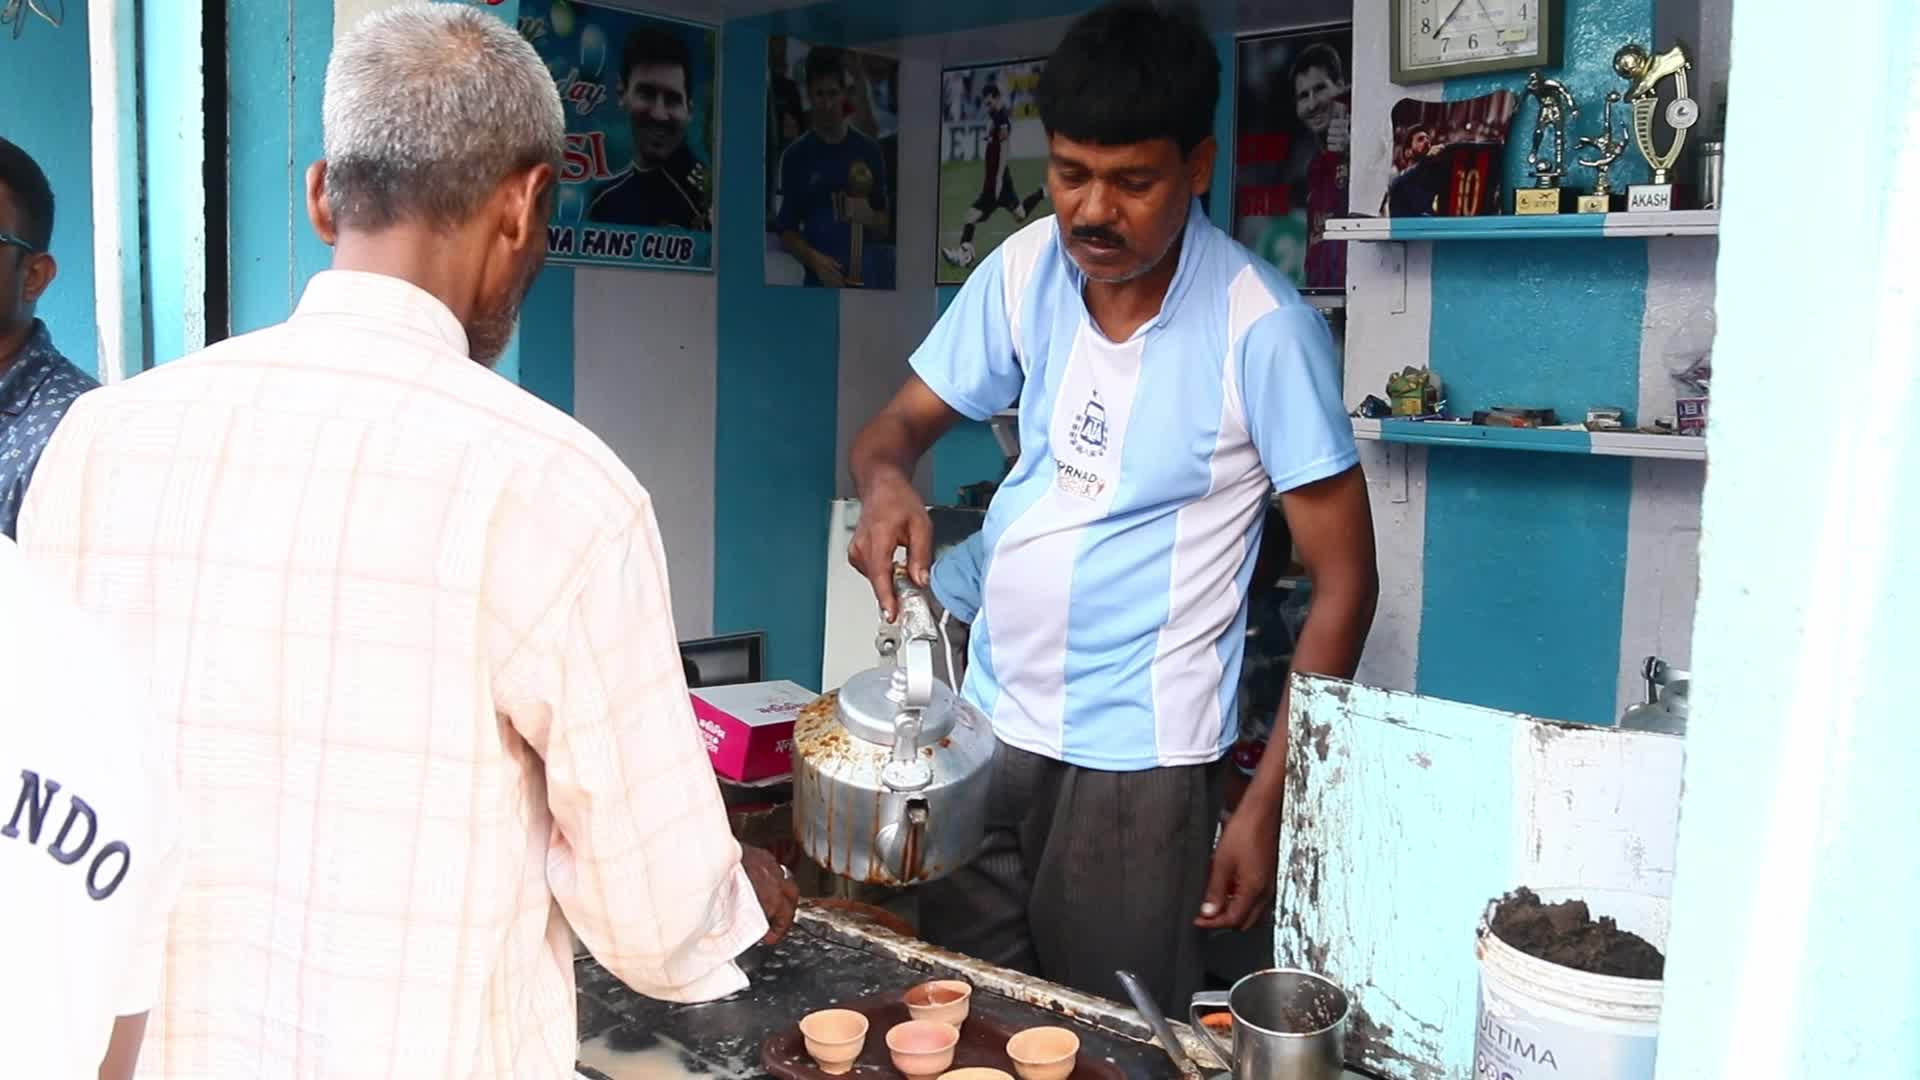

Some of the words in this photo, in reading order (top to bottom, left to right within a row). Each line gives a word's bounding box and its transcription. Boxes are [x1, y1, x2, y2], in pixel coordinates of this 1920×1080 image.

[1518, 3, 1528, 20] 4
[1421, 17, 1431, 34] 8
[1440, 37, 1451, 53] 7
[1468, 33, 1479, 50] 6
[1456, 168, 1480, 216] 10
[1631, 192, 1669, 208] AKASH
[579, 227, 638, 258] FANS
[640, 232, 695, 263] CLUB
[1, 769, 131, 901] NDO
[1480, 1015, 1558, 1070] ULTIMA
